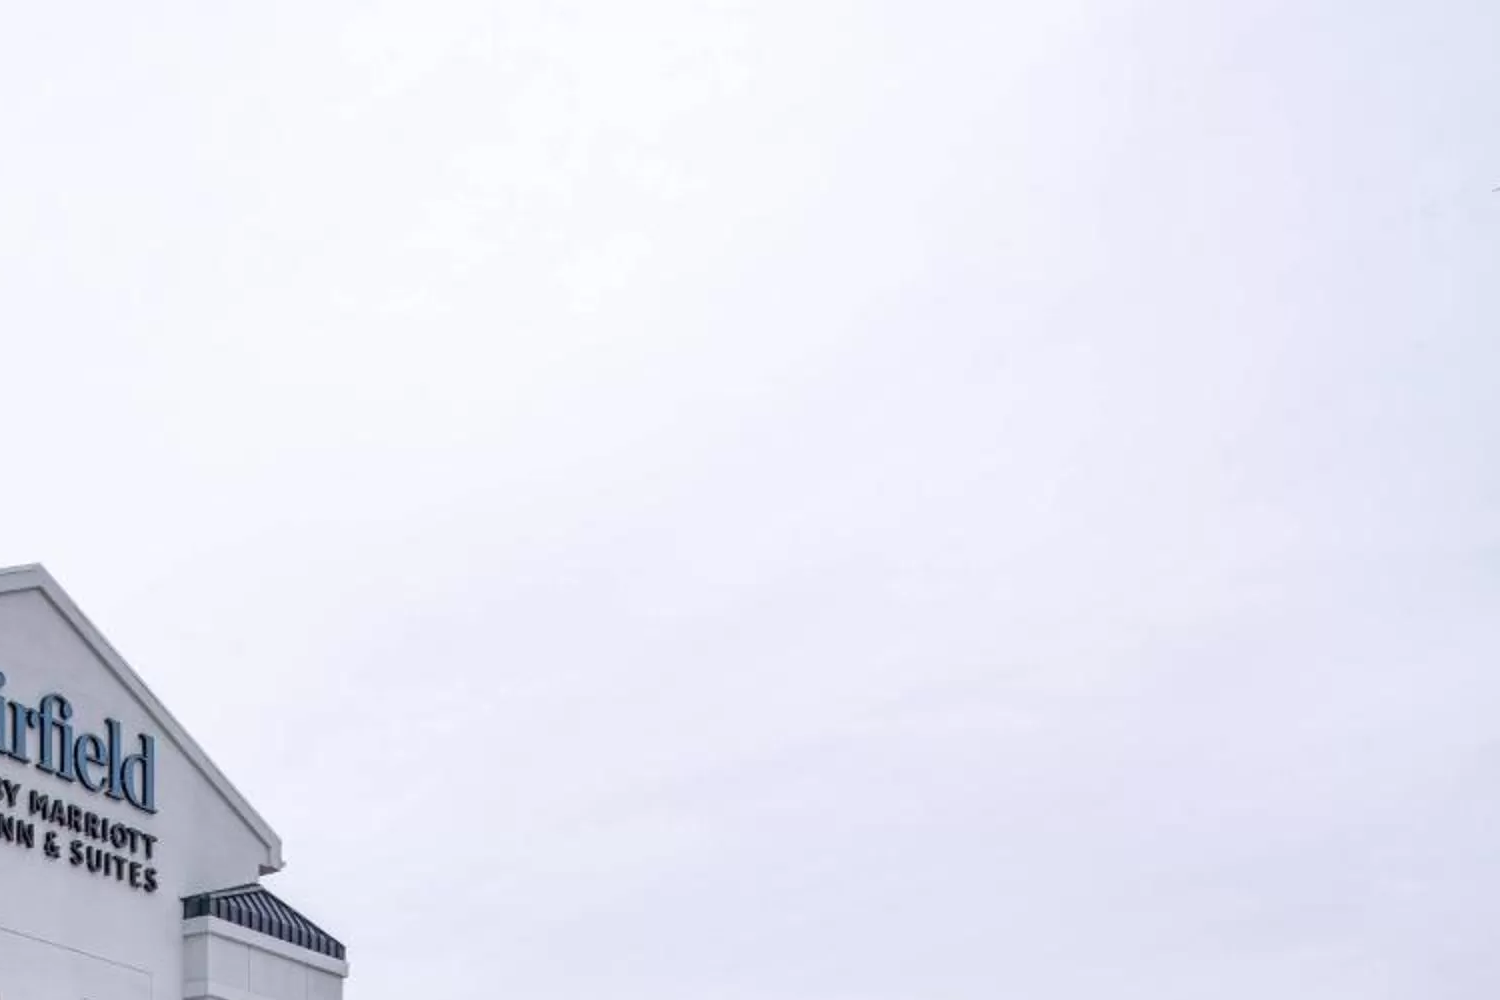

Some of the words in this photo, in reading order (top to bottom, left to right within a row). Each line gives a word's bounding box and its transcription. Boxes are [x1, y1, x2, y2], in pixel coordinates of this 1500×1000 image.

[28, 788, 159, 860] MARRIOTT
[43, 830, 62, 860] &
[69, 839, 159, 893] SUITES
